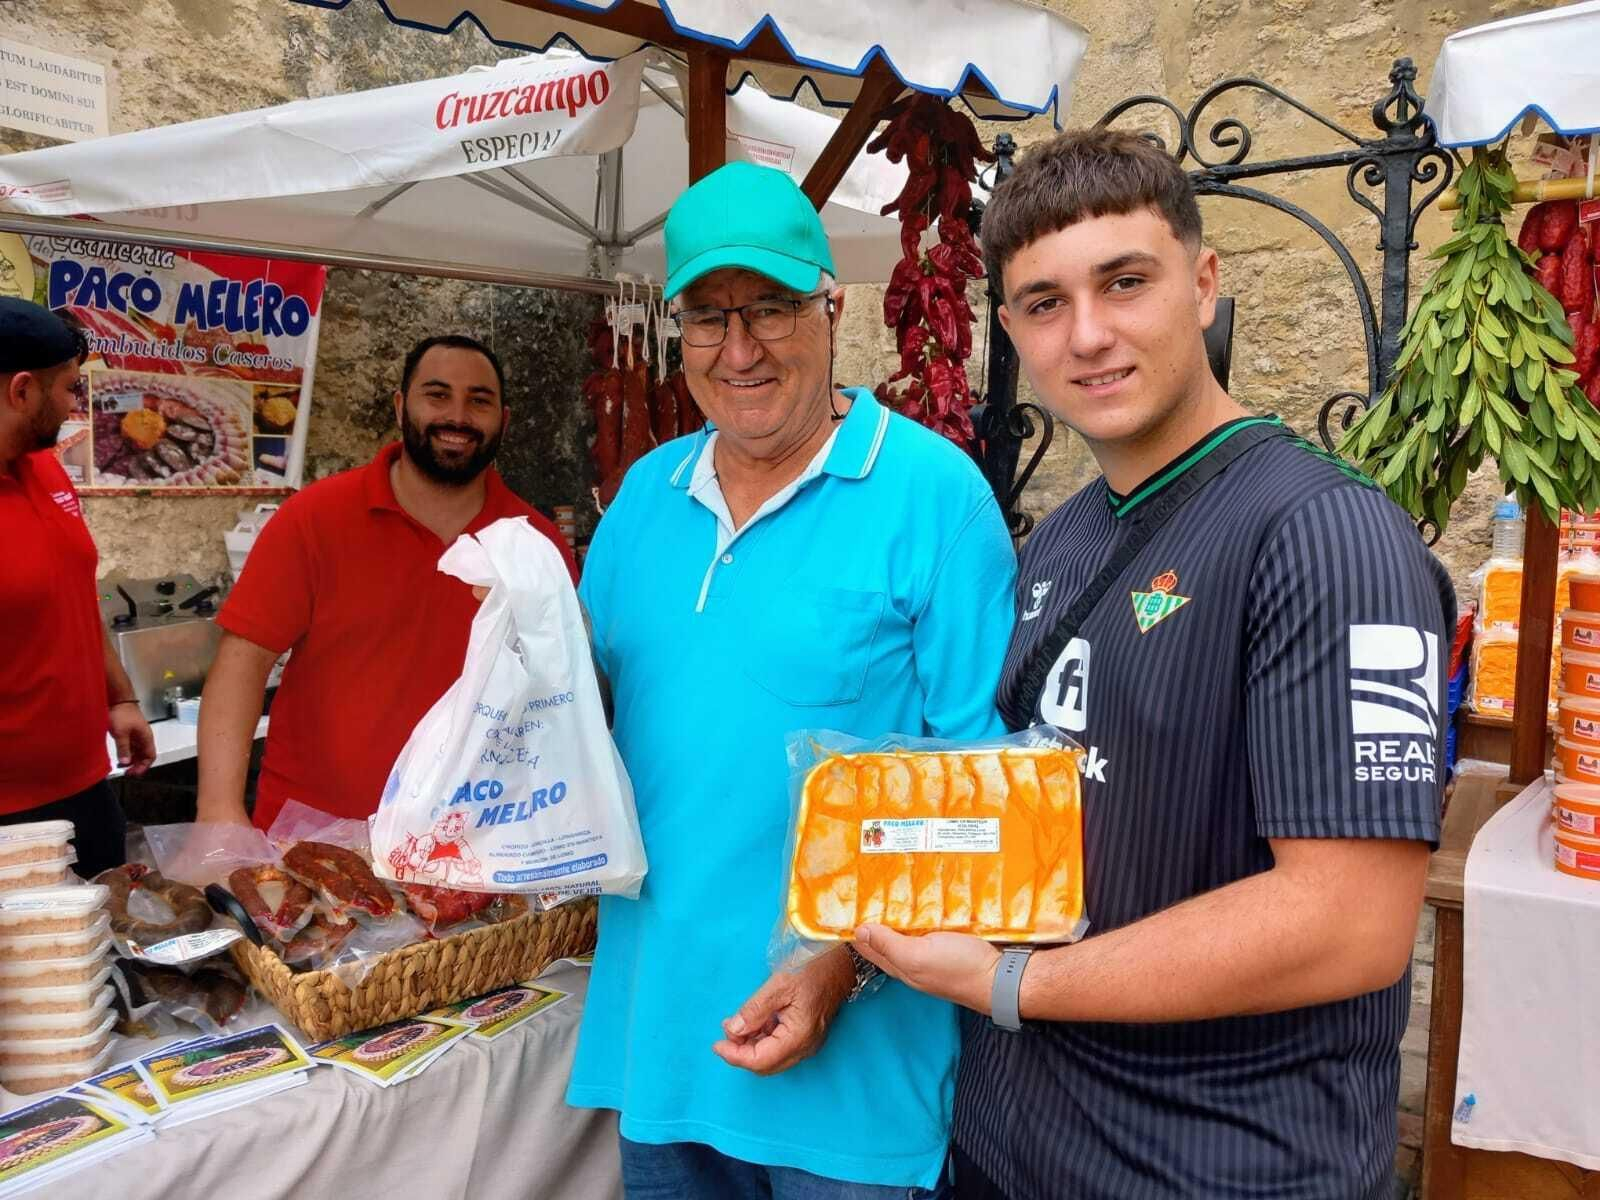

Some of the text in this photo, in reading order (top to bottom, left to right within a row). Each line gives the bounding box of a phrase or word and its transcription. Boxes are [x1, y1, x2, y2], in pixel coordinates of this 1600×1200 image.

[6, 78, 28, 93] EST
[31, 85, 75, 105] DOMINI
[436, 69, 610, 130] Cruzcampo
[49, 259, 310, 338] PACO MELERO
[213, 343, 294, 371] Caseros
[528, 691, 575, 713] PRIMERO
[1354, 740, 1436, 764] REAL
[1354, 766, 1436, 784] SEGUR
